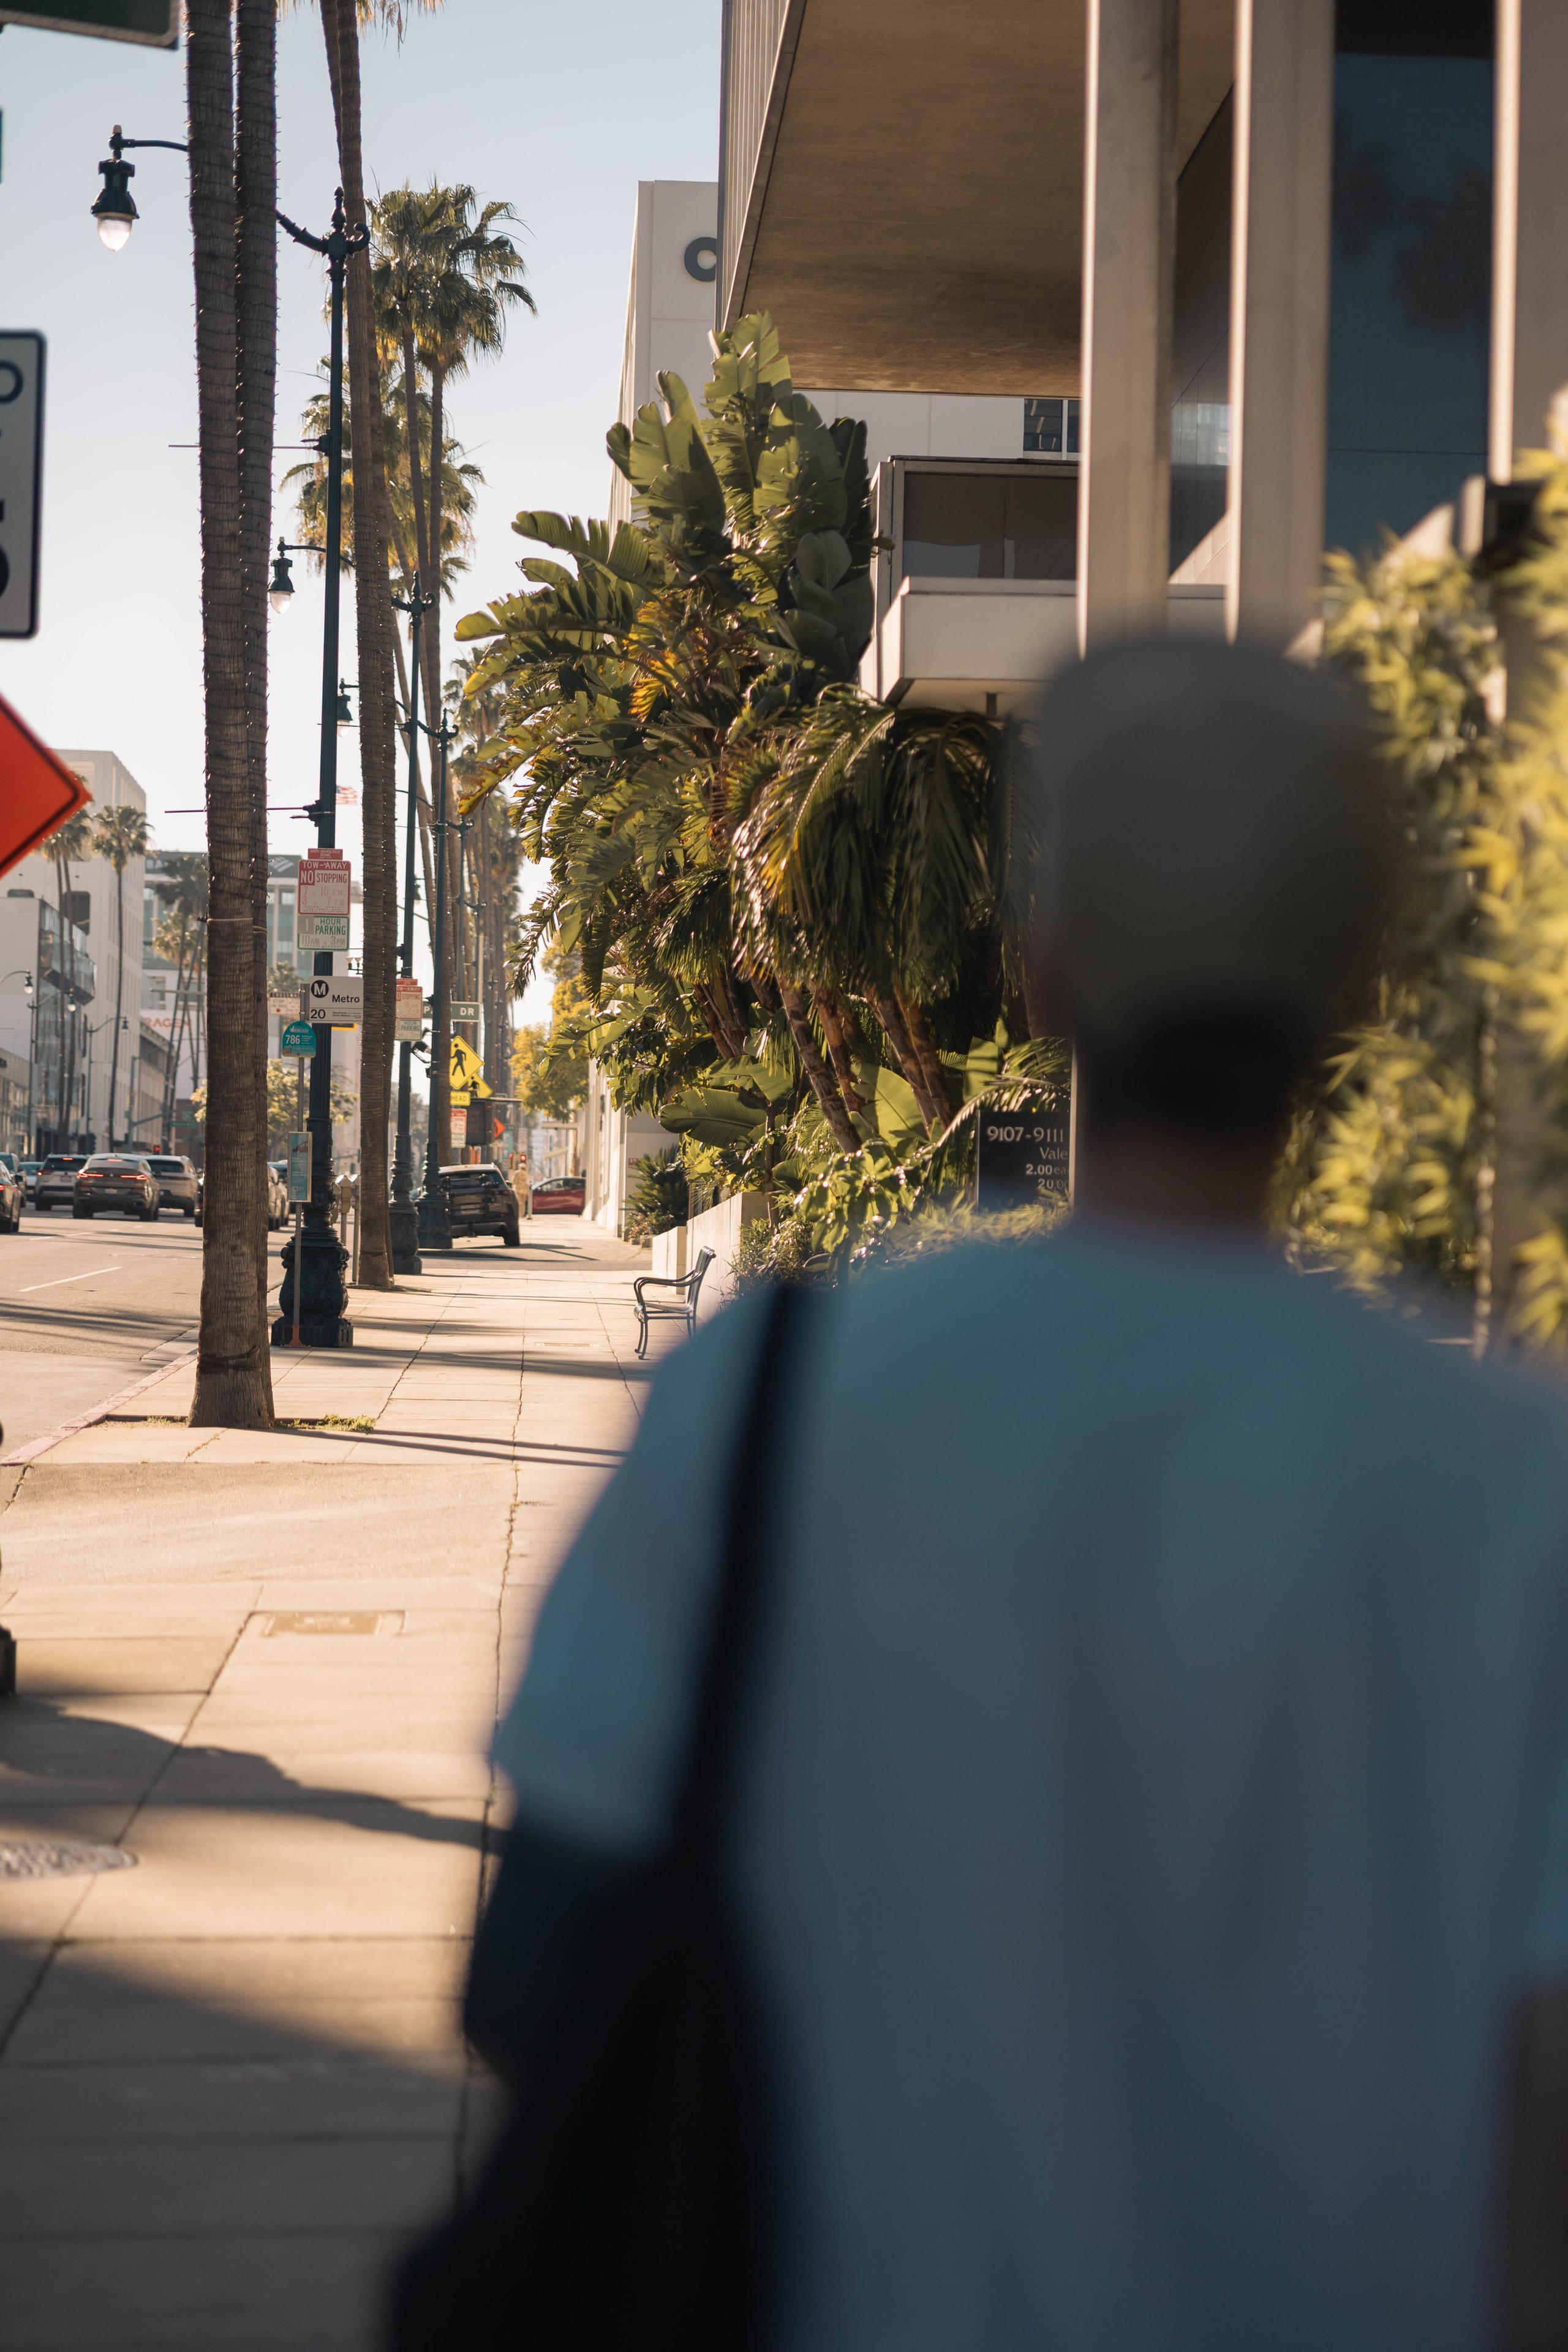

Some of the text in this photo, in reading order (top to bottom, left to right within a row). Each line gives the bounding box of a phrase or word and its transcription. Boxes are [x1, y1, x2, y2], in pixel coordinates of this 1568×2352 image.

[301, 870, 314, 884] NO
[317, 873, 347, 883] STOPPING
[320, 886, 328, 896] 10
[315, 925, 346, 935] PARKING
[311, 1009, 326, 1019] 20
[460, 1007, 474, 1016] DR
[285, 1035, 300, 1044] 786
[1039, 1147, 1068, 1160] Vale
[1025, 1164, 1052, 1175] 2.00
